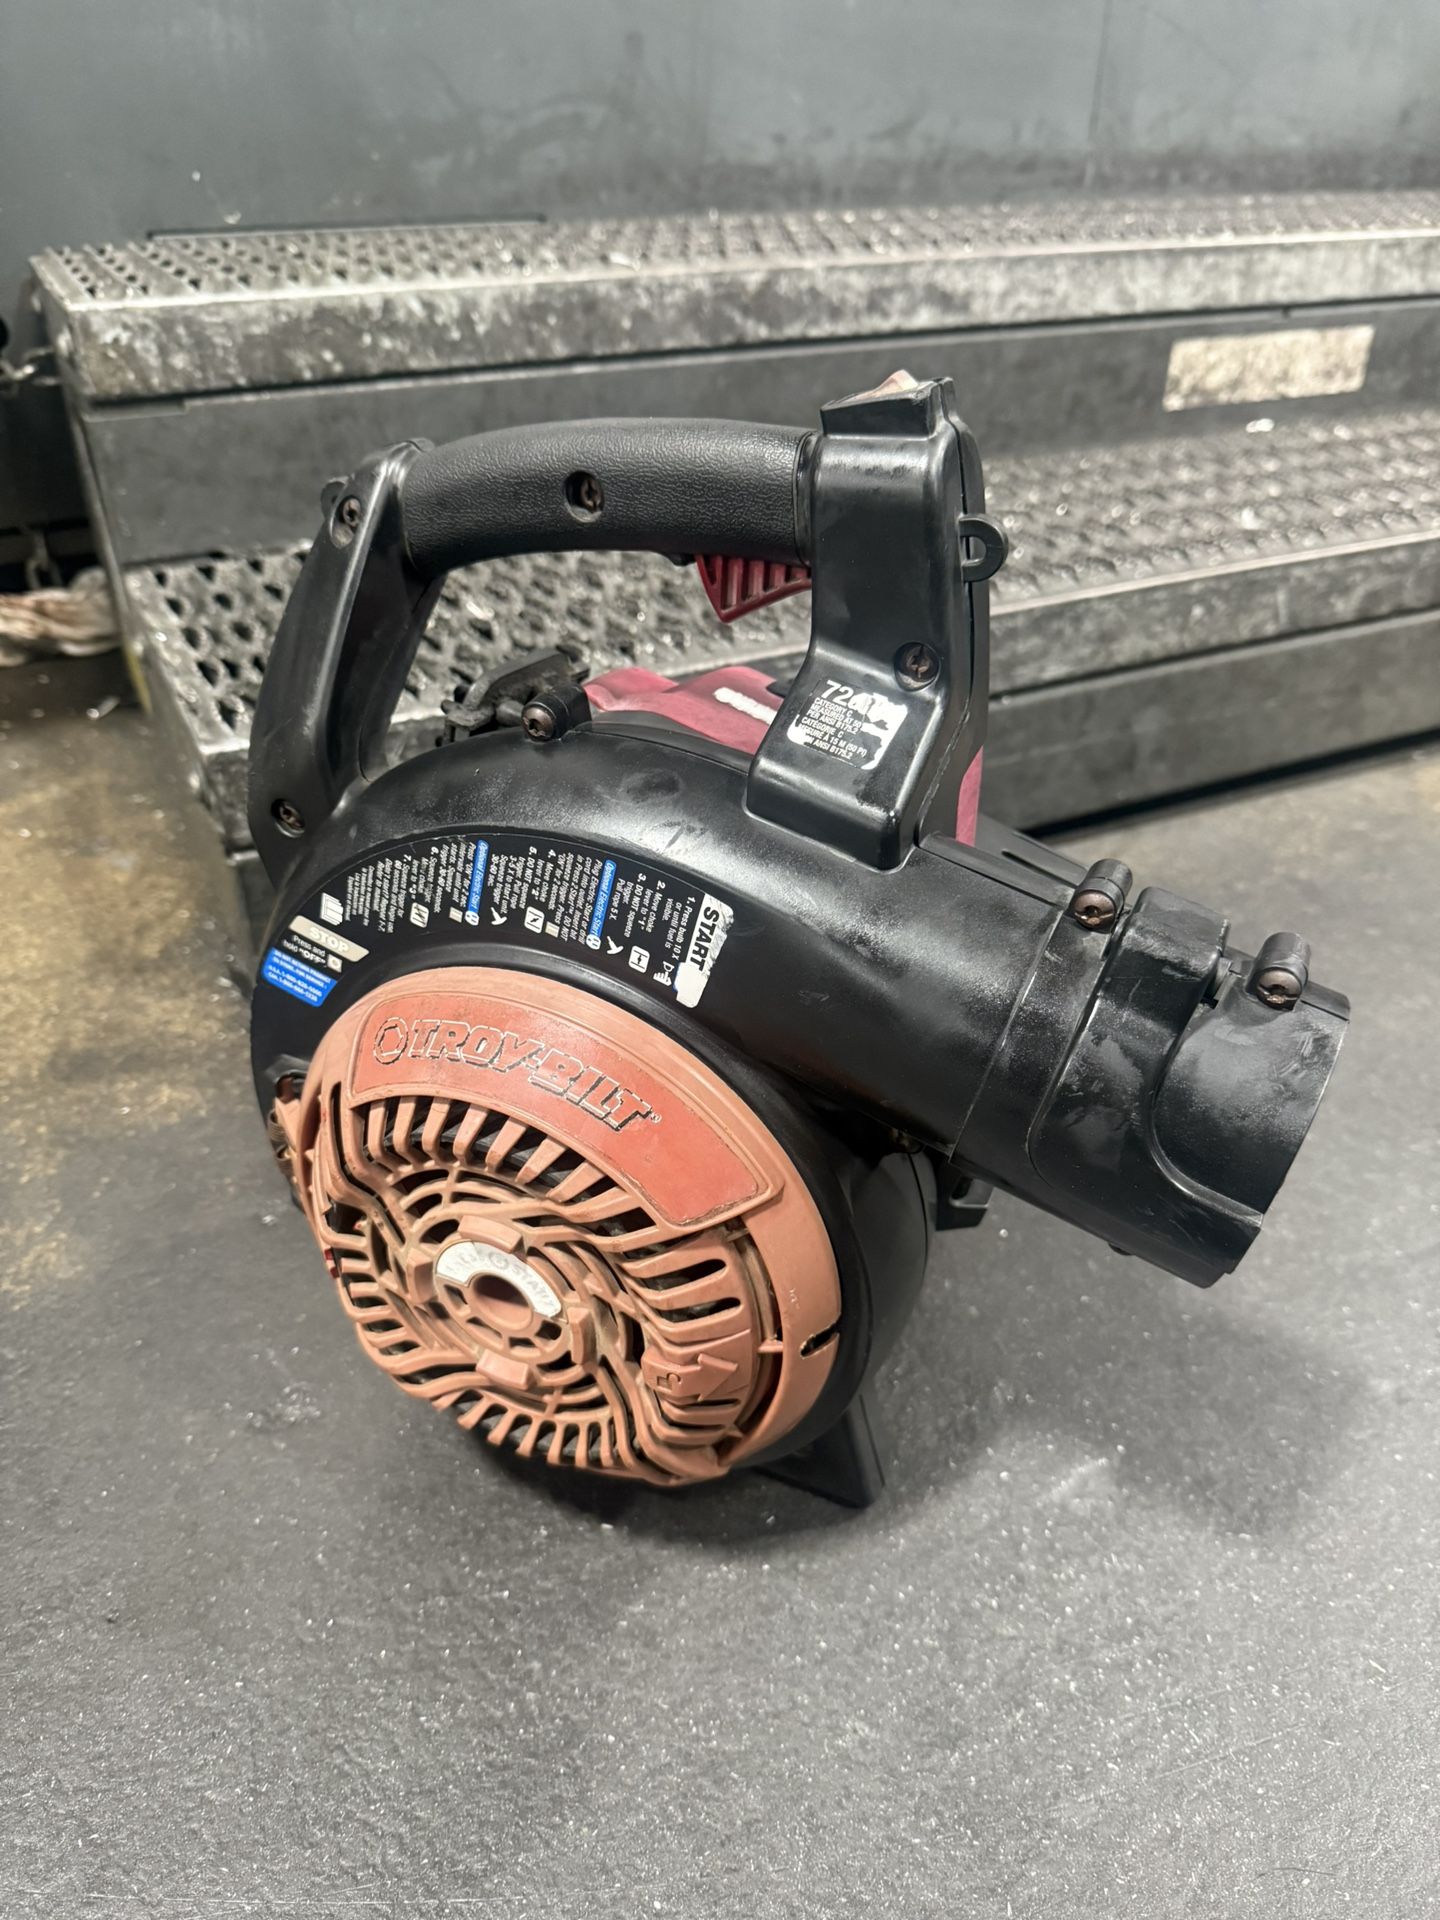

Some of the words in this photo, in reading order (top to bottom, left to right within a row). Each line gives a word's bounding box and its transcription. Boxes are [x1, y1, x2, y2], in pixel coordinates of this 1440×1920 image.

[811, 704, 844, 721] MEASURED
[815, 698, 847, 714] CATEGORY
[807, 710, 820, 719] PER
[820, 715, 836, 725] ANSI
[836, 722, 858, 734] B175.2
[813, 739, 830, 750] ANSI
[830, 746, 853, 759] B175.2
[403, 854, 411, 862] 7.
[449, 843, 458, 864] starts.
[457, 843, 467, 871] intervals
[467, 842, 476, 861] Press
[476, 842, 488, 871] Optional
[529, 847, 537, 856] 5.
[548, 849, 556, 859] 4.
[576, 854, 584, 863] in
[412, 859, 420, 874] lever
[490, 854, 499, 874] 30-60
[497, 855, 508, 882] Squeeze
[508, 855, 516, 868] 3-5
[514, 856, 525, 879] trigger.
[526, 857, 535, 868] DO
[535, 859, 545, 877] lever
[562, 852, 574, 881] squeeze
[584, 857, 593, 873] cord
[592, 859, 602, 876] Plug
[400, 863, 409, 889] Squeeze
[444, 866, 455, 892] Squeeze
[455, 872, 463, 888] until
[524, 868, 533, 883] NOT
[544, 862, 553, 881] Move
[572, 863, 582, 882] Press
[600, 862, 614, 891] Optional
[638, 873, 646, 883] 3.
[463, 879, 471, 888] for
[473, 871, 483, 894] Electric
[487, 874, 495, 887] sec.
[513, 880, 521, 893] Pull
[533, 877, 541, 885] to
[581, 874, 589, 887] into
[616, 878, 625, 892] Pull
[657, 881, 665, 891] 2.
[453, 888, 461, 902] unit
[492, 883, 503, 904] trigger
[504, 883, 512, 899] start
[519, 882, 529, 909] squeeze
[539, 881, 550, 902] choke
[548, 884, 559, 911] seconds.
[558, 881, 569, 903] trigger.
[586, 876, 598, 903] Electric
[622, 881, 634, 904] trigger.
[634, 884, 642, 896] DO
[643, 889, 653, 907] lever
[397, 889, 406, 909] trigger
[460, 895, 468, 907] sec.
[471, 894, 480, 909] Start
[501, 900, 509, 914] unit.
[509, 894, 518, 909] rope
[576, 889, 586, 909] outlet.
[595, 892, 607, 918] Electric
[611, 892, 621, 907] rope
[631, 896, 640, 911] NOT
[651, 892, 662, 911] Move
[675, 902, 682, 911] or
[687, 896, 695, 905] 1.
[554, 904, 564, 924] Press
[583, 903, 593, 920] Start
[609, 913, 617, 921] X.
[641, 907, 648, 915] to
[662, 898, 674, 922] visible.
[681, 906, 692, 927] Press
[564, 916, 572, 926] DO
[572, 910, 582, 929] Insert
[591, 918, 601, 935] Start
[623, 910, 635, 938] squeeze
[646, 912, 657, 933] choke
[671, 911, 680, 927] until
[308, 927, 350, 953] STOP
[561, 926, 570, 941] NOT
[570, 930, 578, 940] bit
[578, 929, 588, 944] drill
[667, 928, 676, 941] fuel
[676, 927, 686, 943] bulb
[689, 906, 720, 972] START
[282, 940, 299, 953] hold
[292, 935, 313, 950] Press
[312, 946, 326, 957] and
[674, 944, 681, 952] 10
[672, 951, 679, 960] X
[410, 1019, 652, 1131] TROY-BILT
